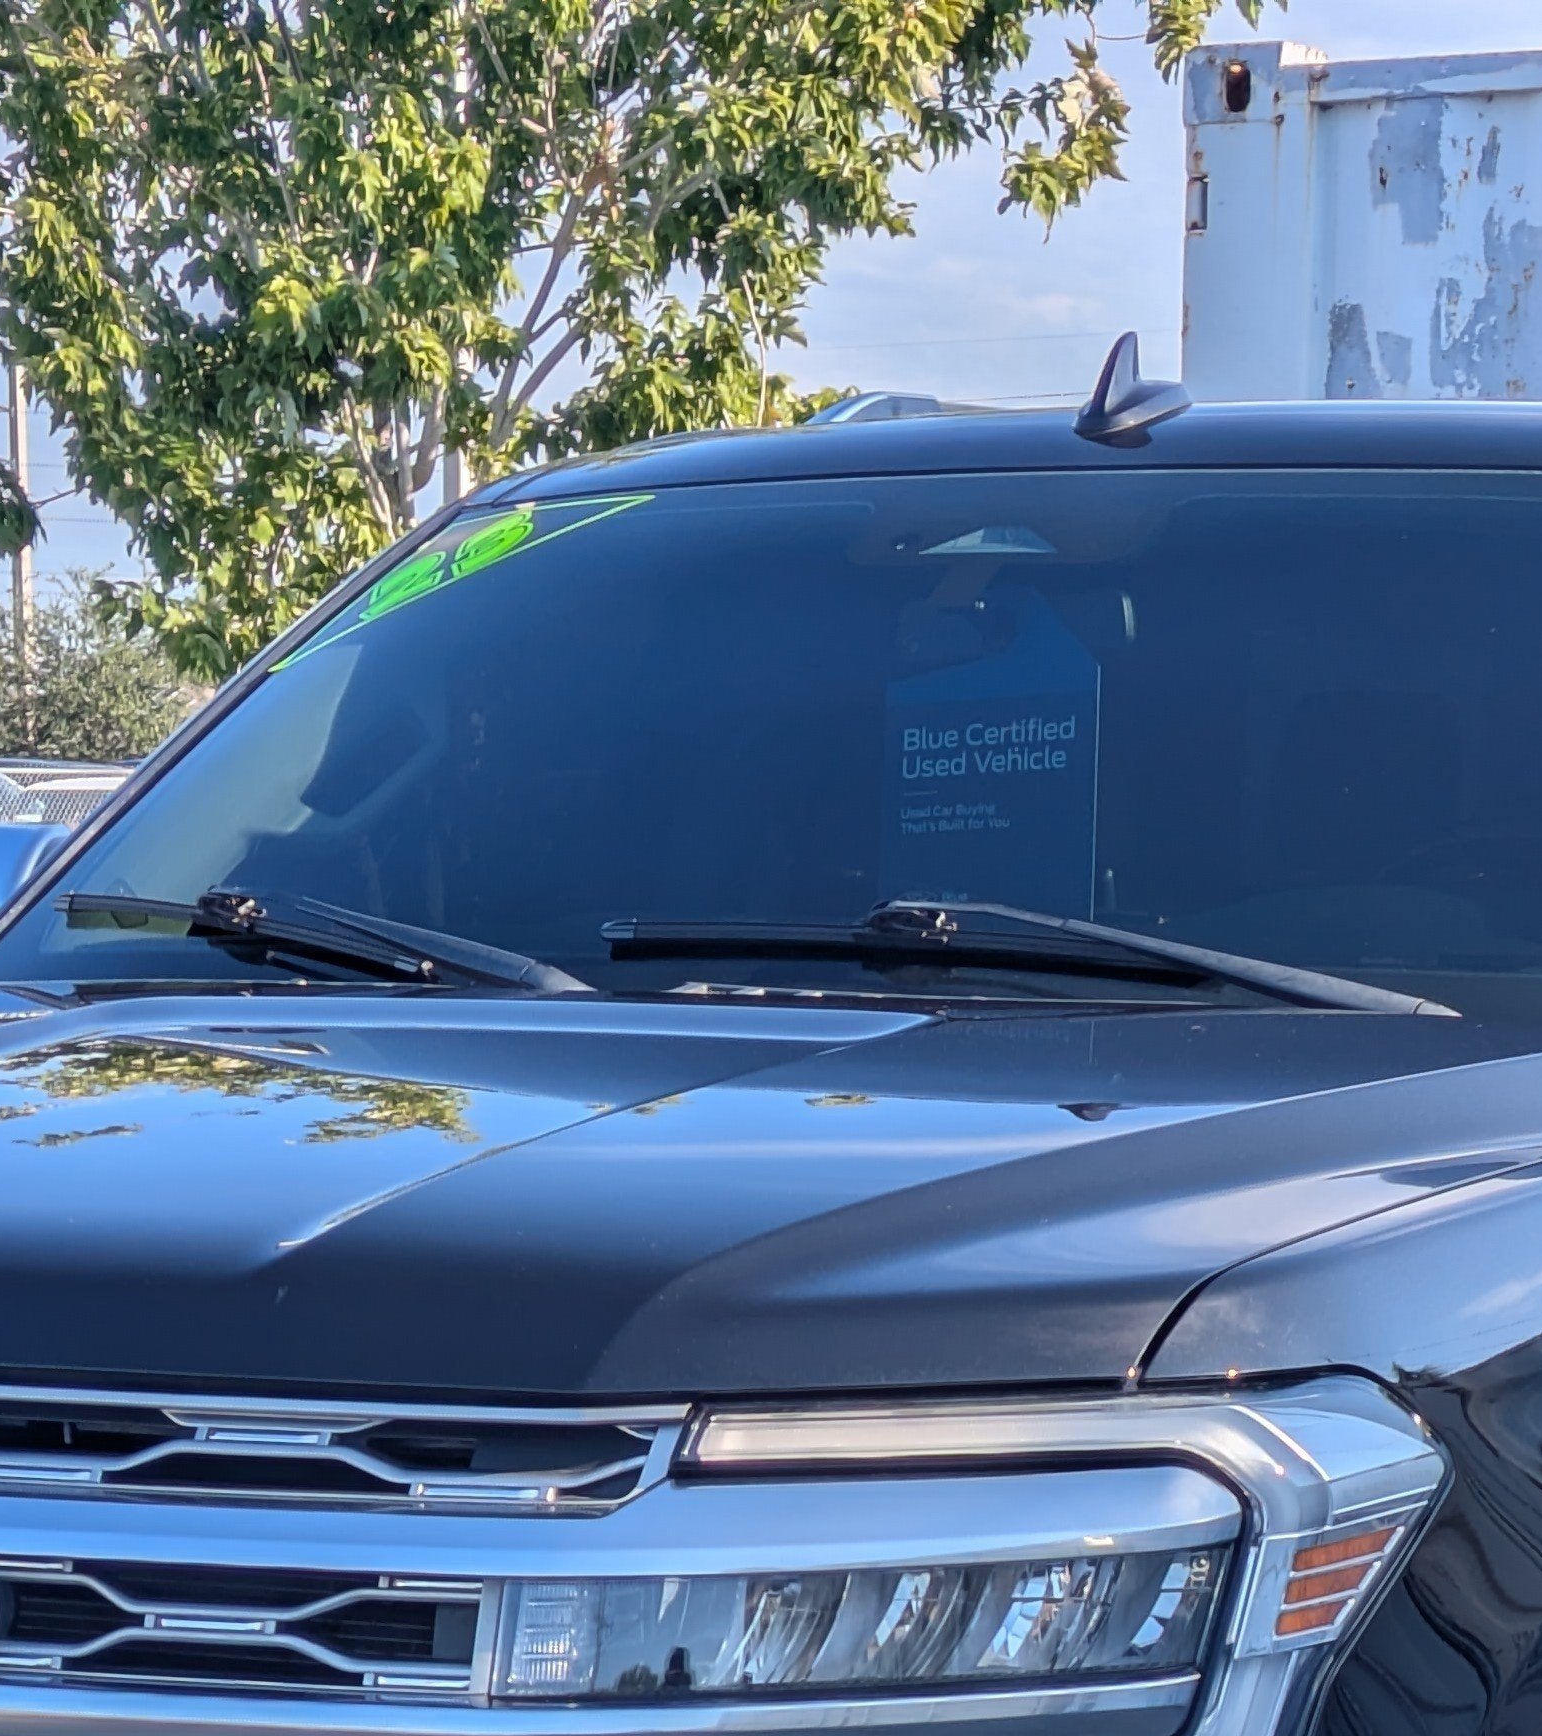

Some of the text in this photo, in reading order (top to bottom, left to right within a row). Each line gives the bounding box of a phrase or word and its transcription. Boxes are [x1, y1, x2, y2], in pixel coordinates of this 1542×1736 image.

[903, 715, 1076, 751] Blue Certified
[902, 745, 1067, 779] Used Vehicle
